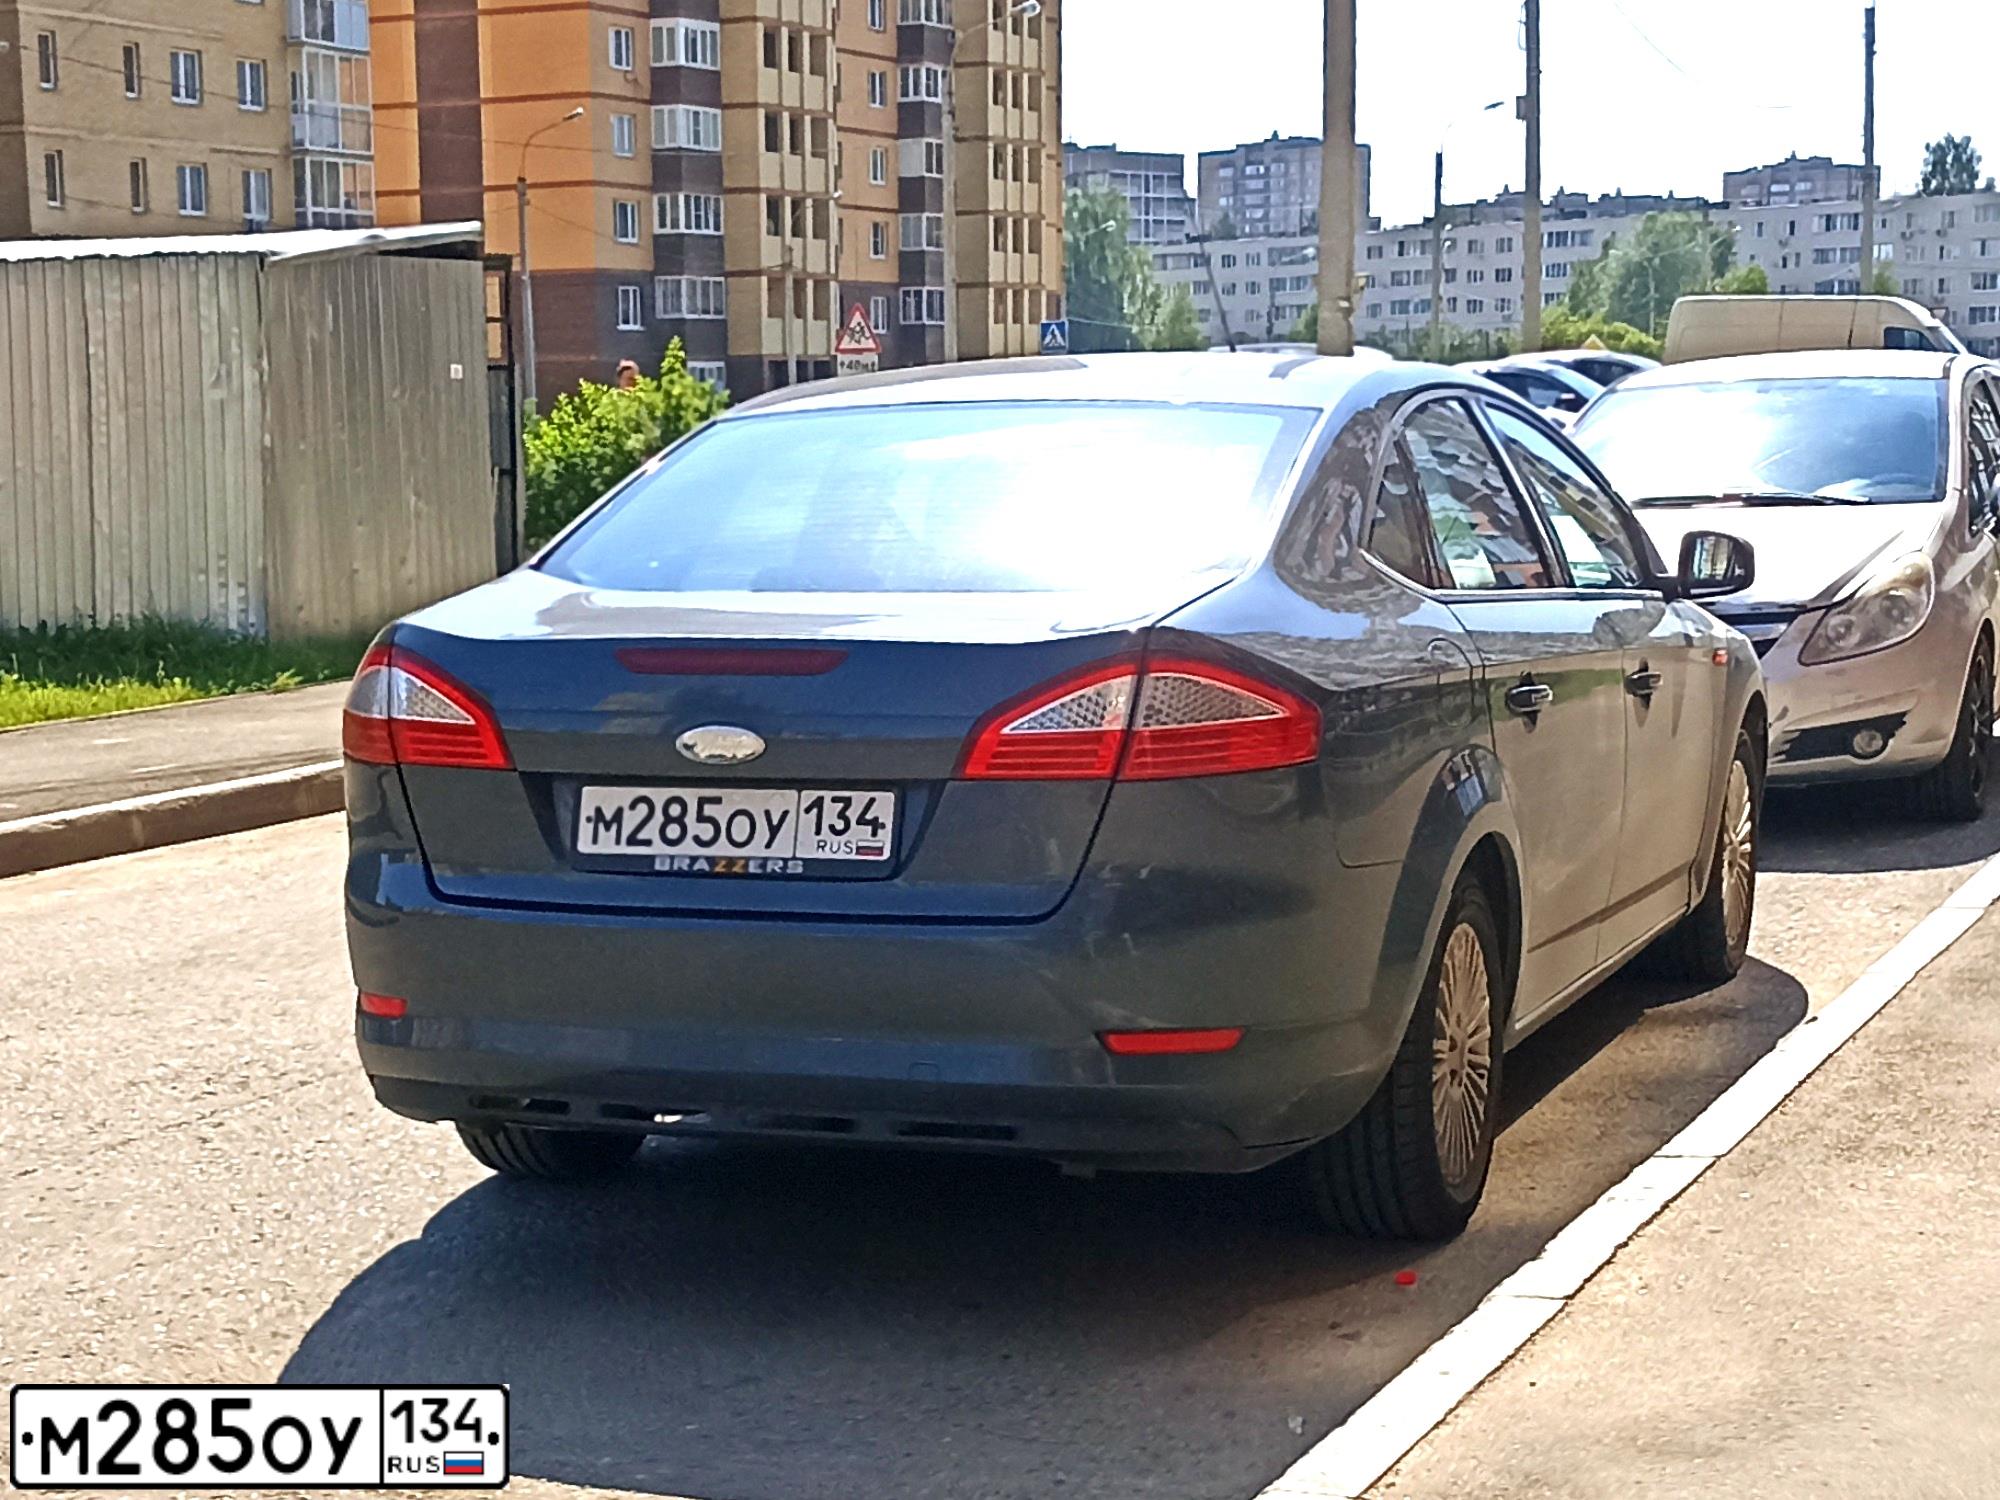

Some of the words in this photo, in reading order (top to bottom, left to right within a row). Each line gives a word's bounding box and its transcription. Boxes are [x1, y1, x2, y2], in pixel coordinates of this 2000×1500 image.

[592, 795, 790, 850] М285ОУ
[804, 796, 880, 838] 134
[816, 839, 854, 855] RUS
[654, 856, 804, 874] BRAZZERS
